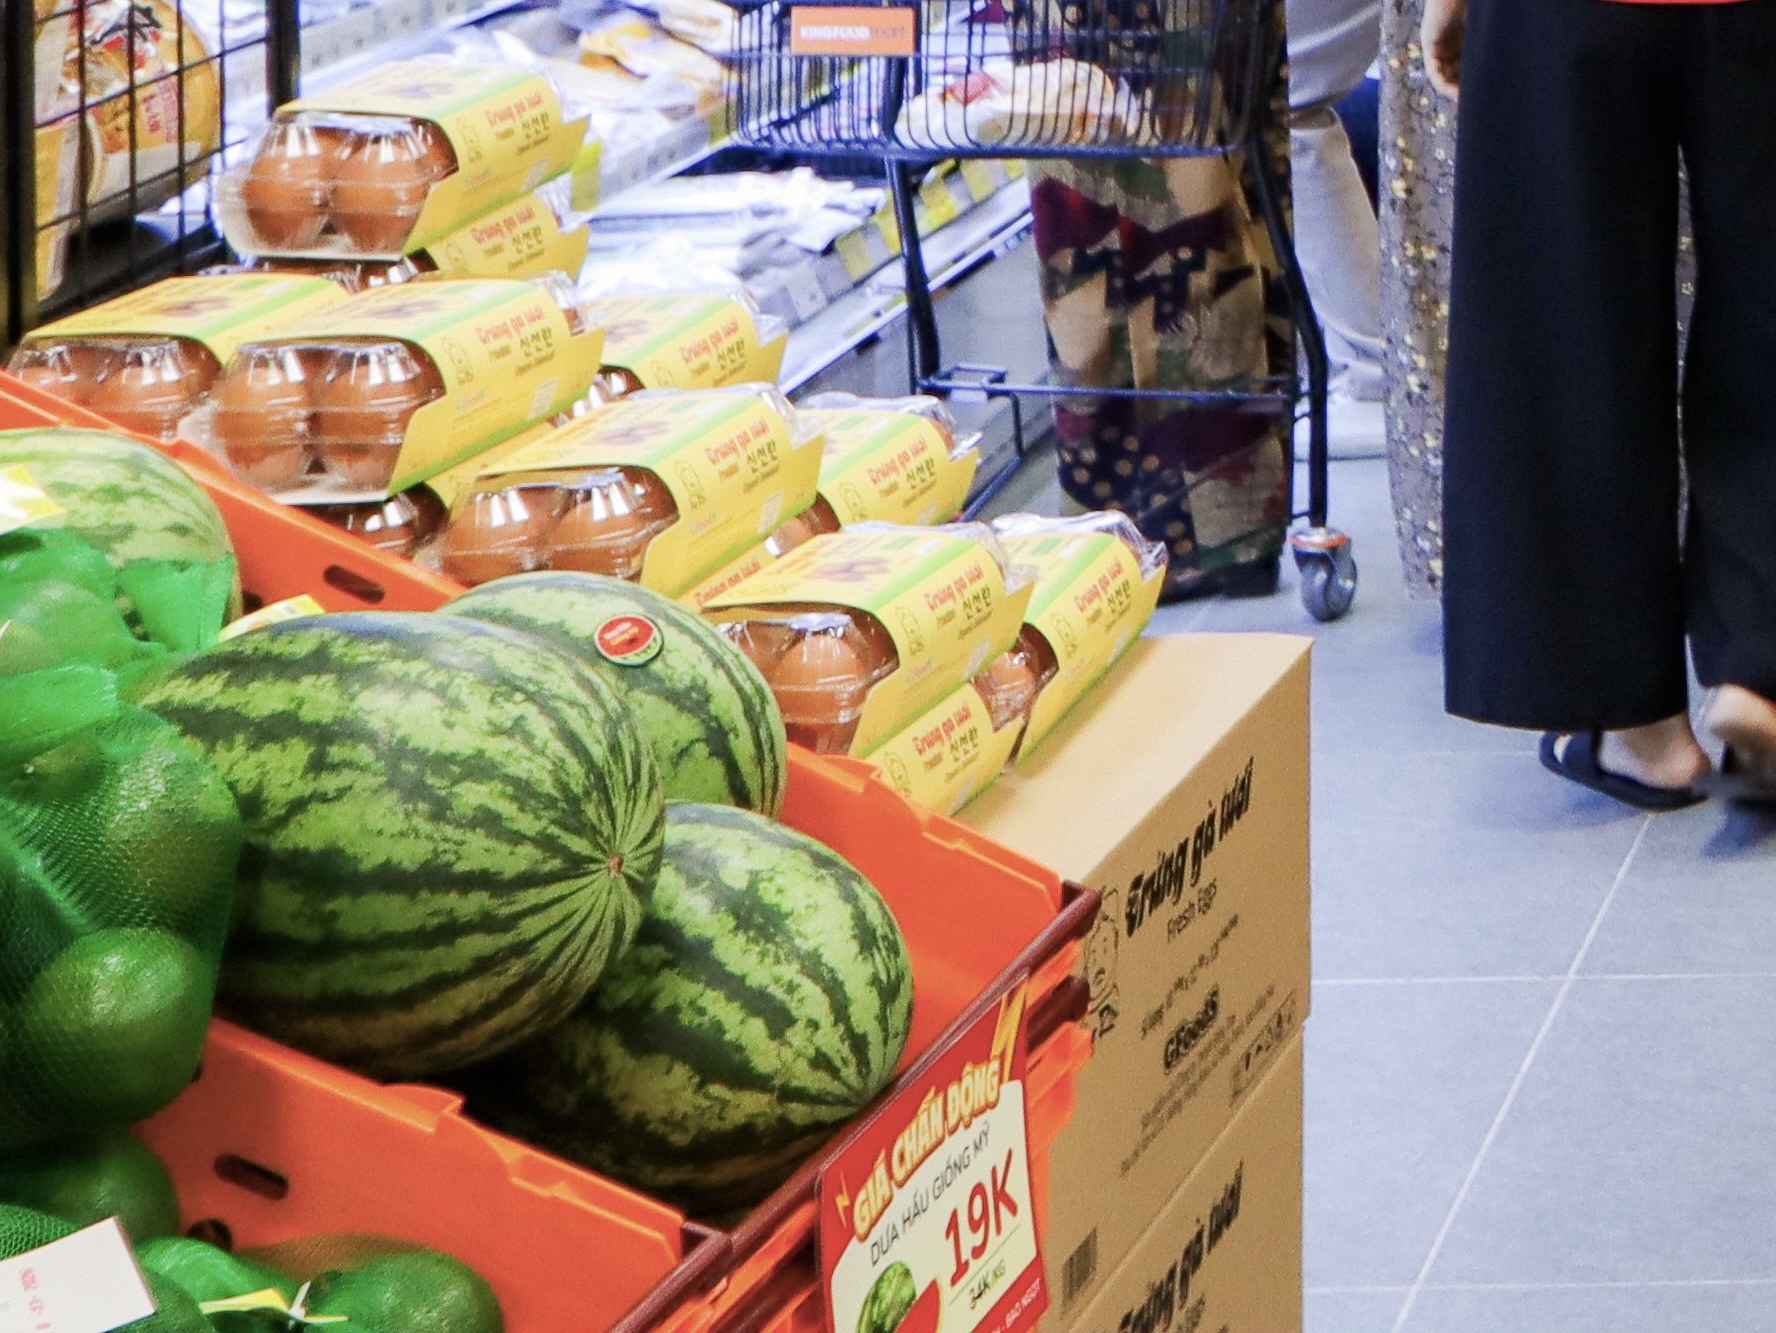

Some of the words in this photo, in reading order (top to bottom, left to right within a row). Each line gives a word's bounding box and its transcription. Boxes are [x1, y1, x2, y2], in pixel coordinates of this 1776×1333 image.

[853, 1148, 894, 1243] GIÁ
[891, 1085, 946, 1190] CHẤN
[946, 1055, 1001, 1137] ĐỘNG
[944, 1148, 1019, 1288] 19K
